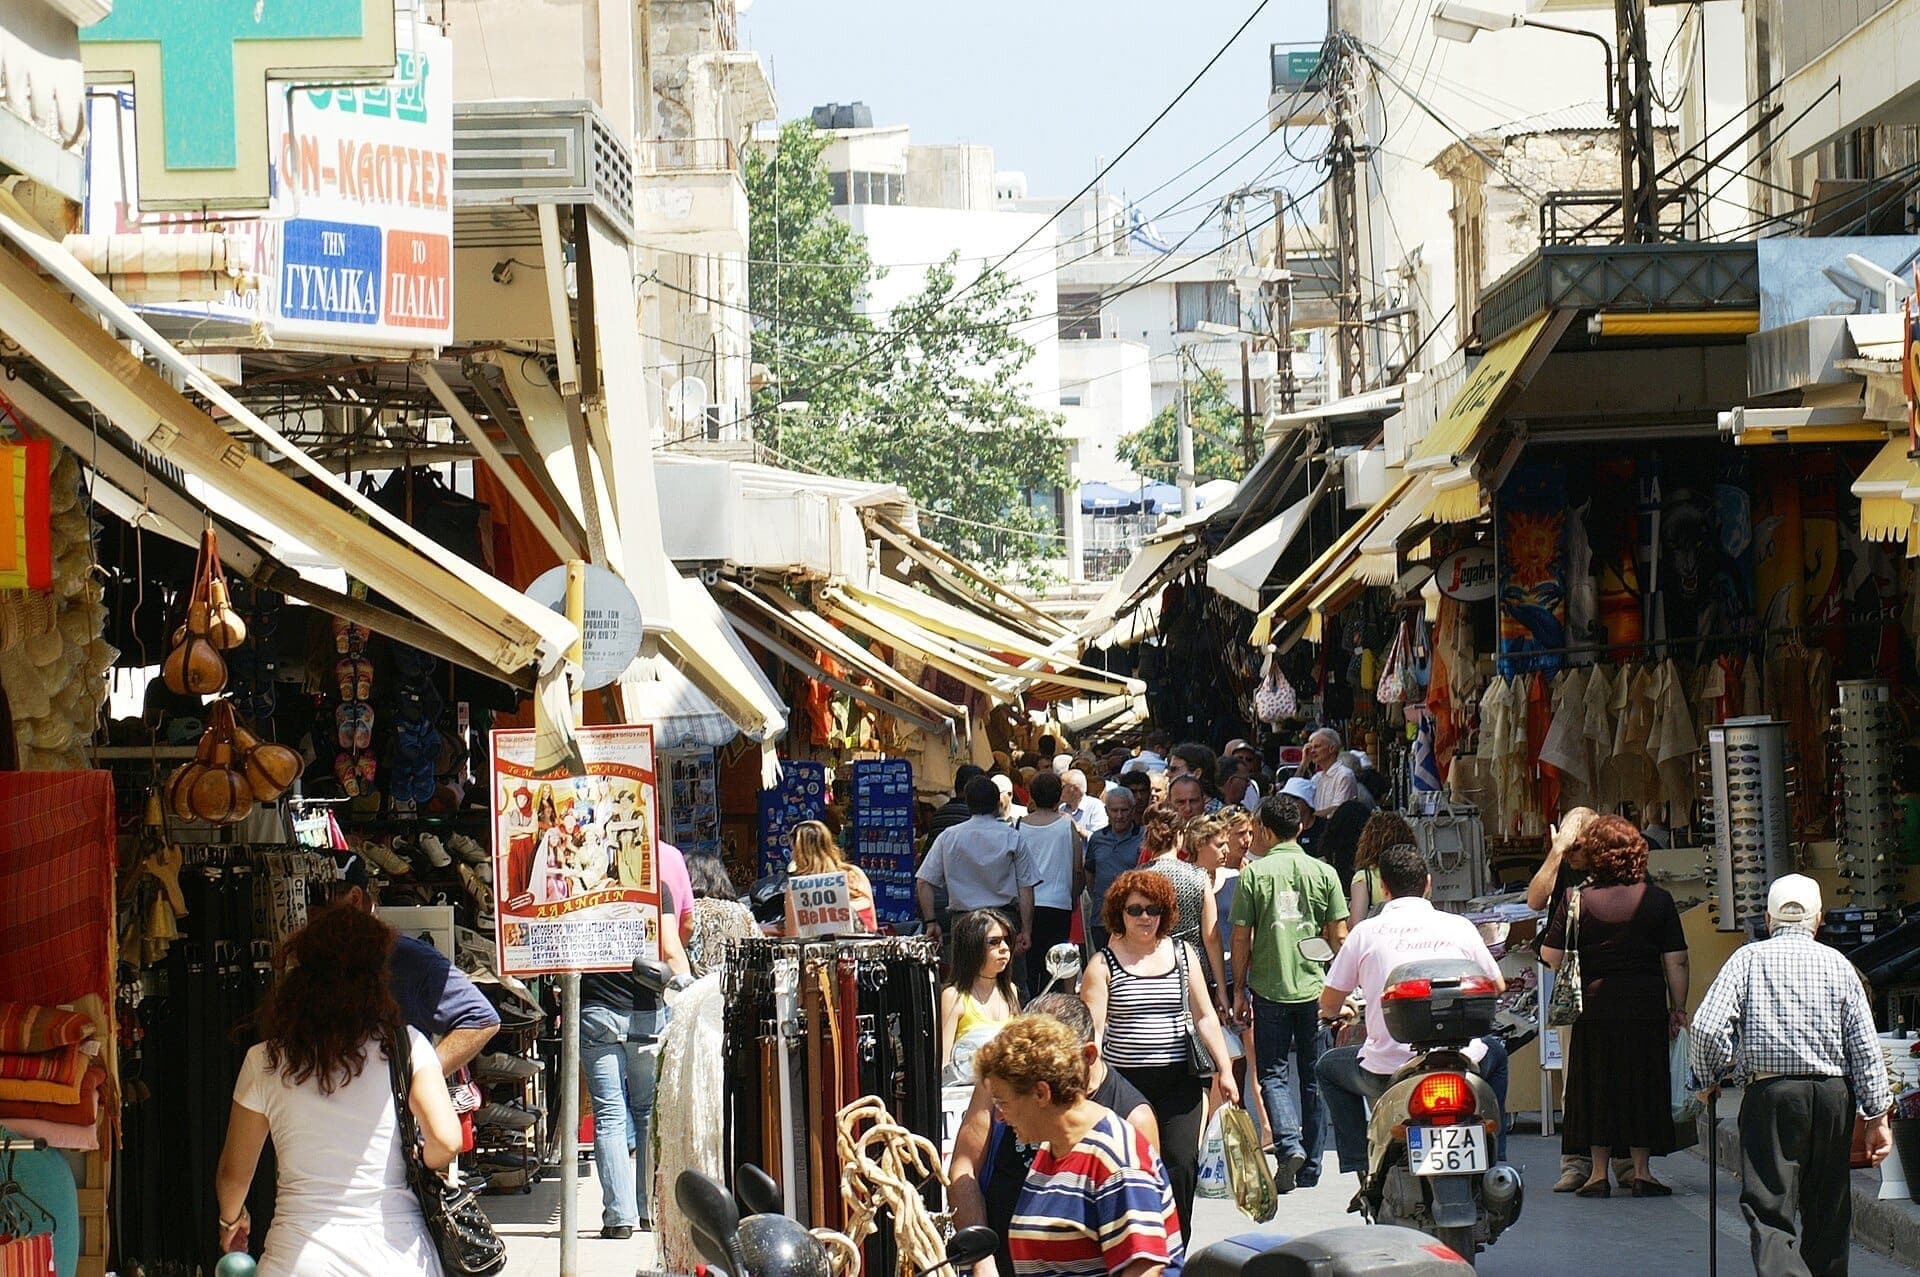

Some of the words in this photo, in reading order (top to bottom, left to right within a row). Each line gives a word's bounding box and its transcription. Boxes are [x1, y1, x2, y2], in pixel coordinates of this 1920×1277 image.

[321, 231, 346, 257] ΤΗΝ
[411, 240, 426, 265] ΤΟ
[284, 263, 377, 316] ΓΥΝΑΙΚΑ
[390, 272, 446, 321] ΠΑΙΔΙ
[800, 889, 837, 908] 3,00
[798, 907, 850, 926] Belts
[1430, 1129, 1476, 1149] HZA
[1430, 1150, 1476, 1170] 561
